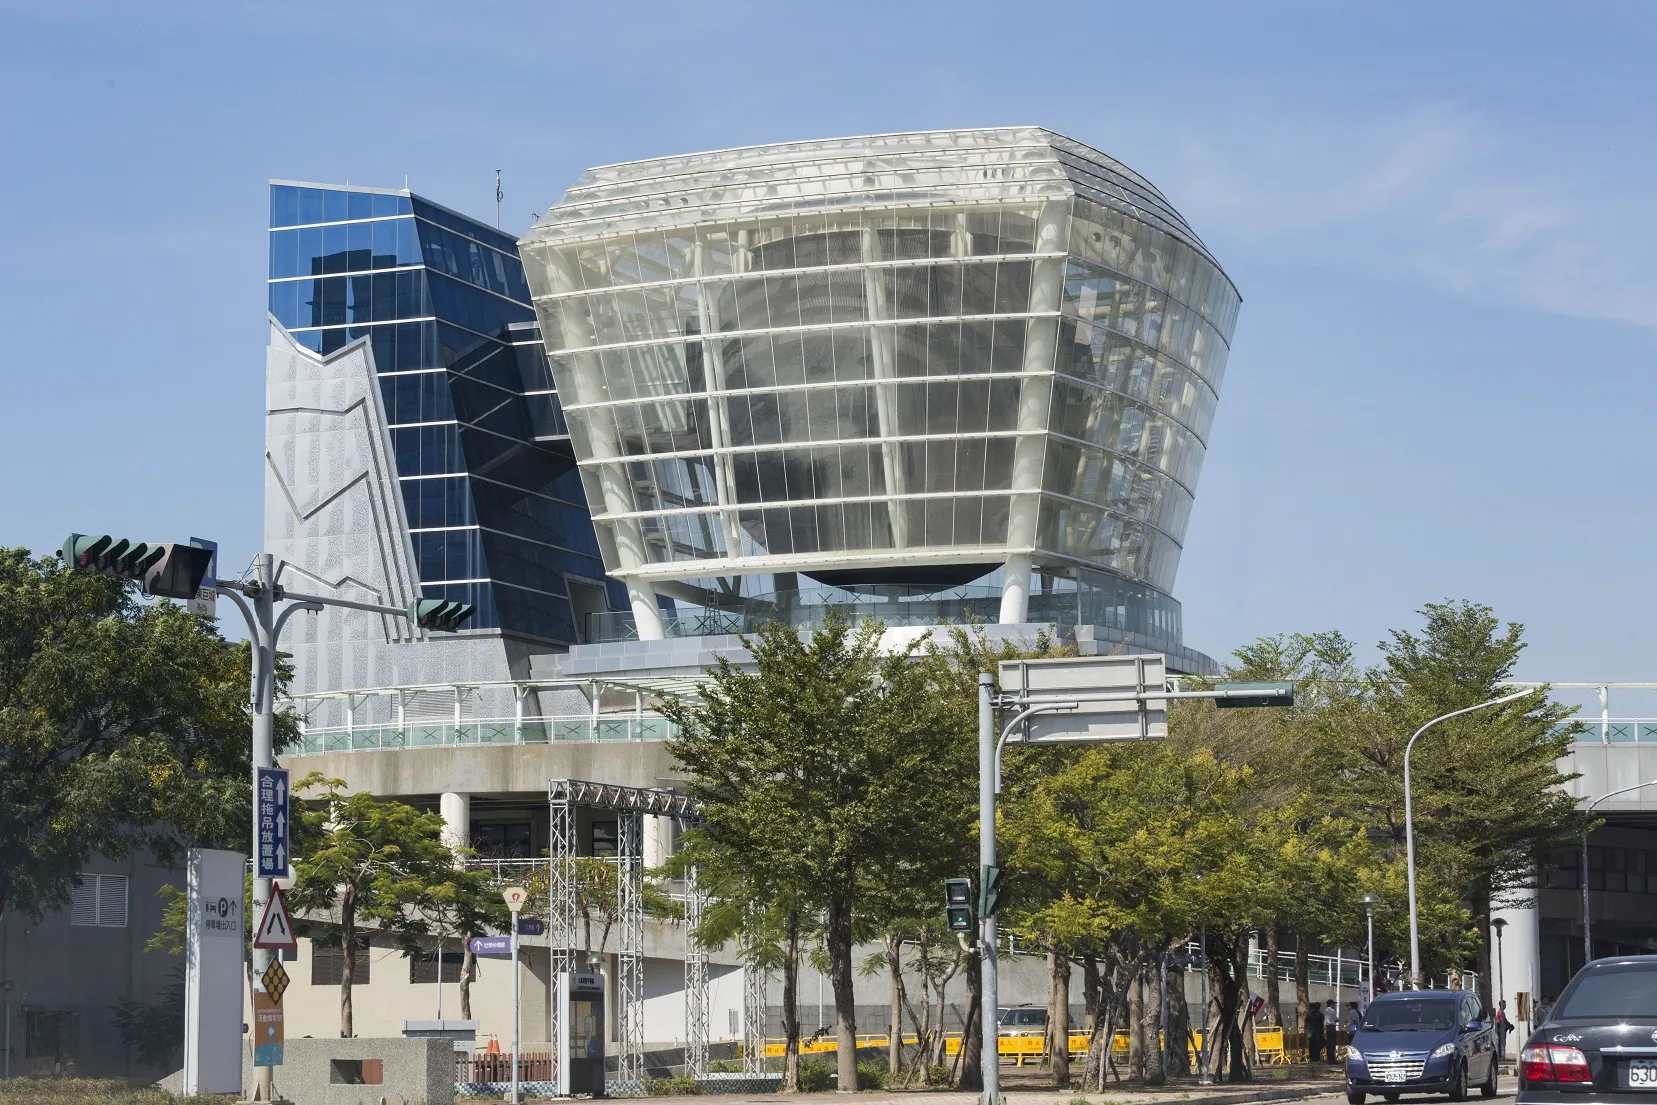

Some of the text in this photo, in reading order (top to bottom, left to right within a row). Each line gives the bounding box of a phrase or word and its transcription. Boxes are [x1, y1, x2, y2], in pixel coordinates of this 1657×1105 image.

[260, 775, 275, 871] 合理拖吊放置場
